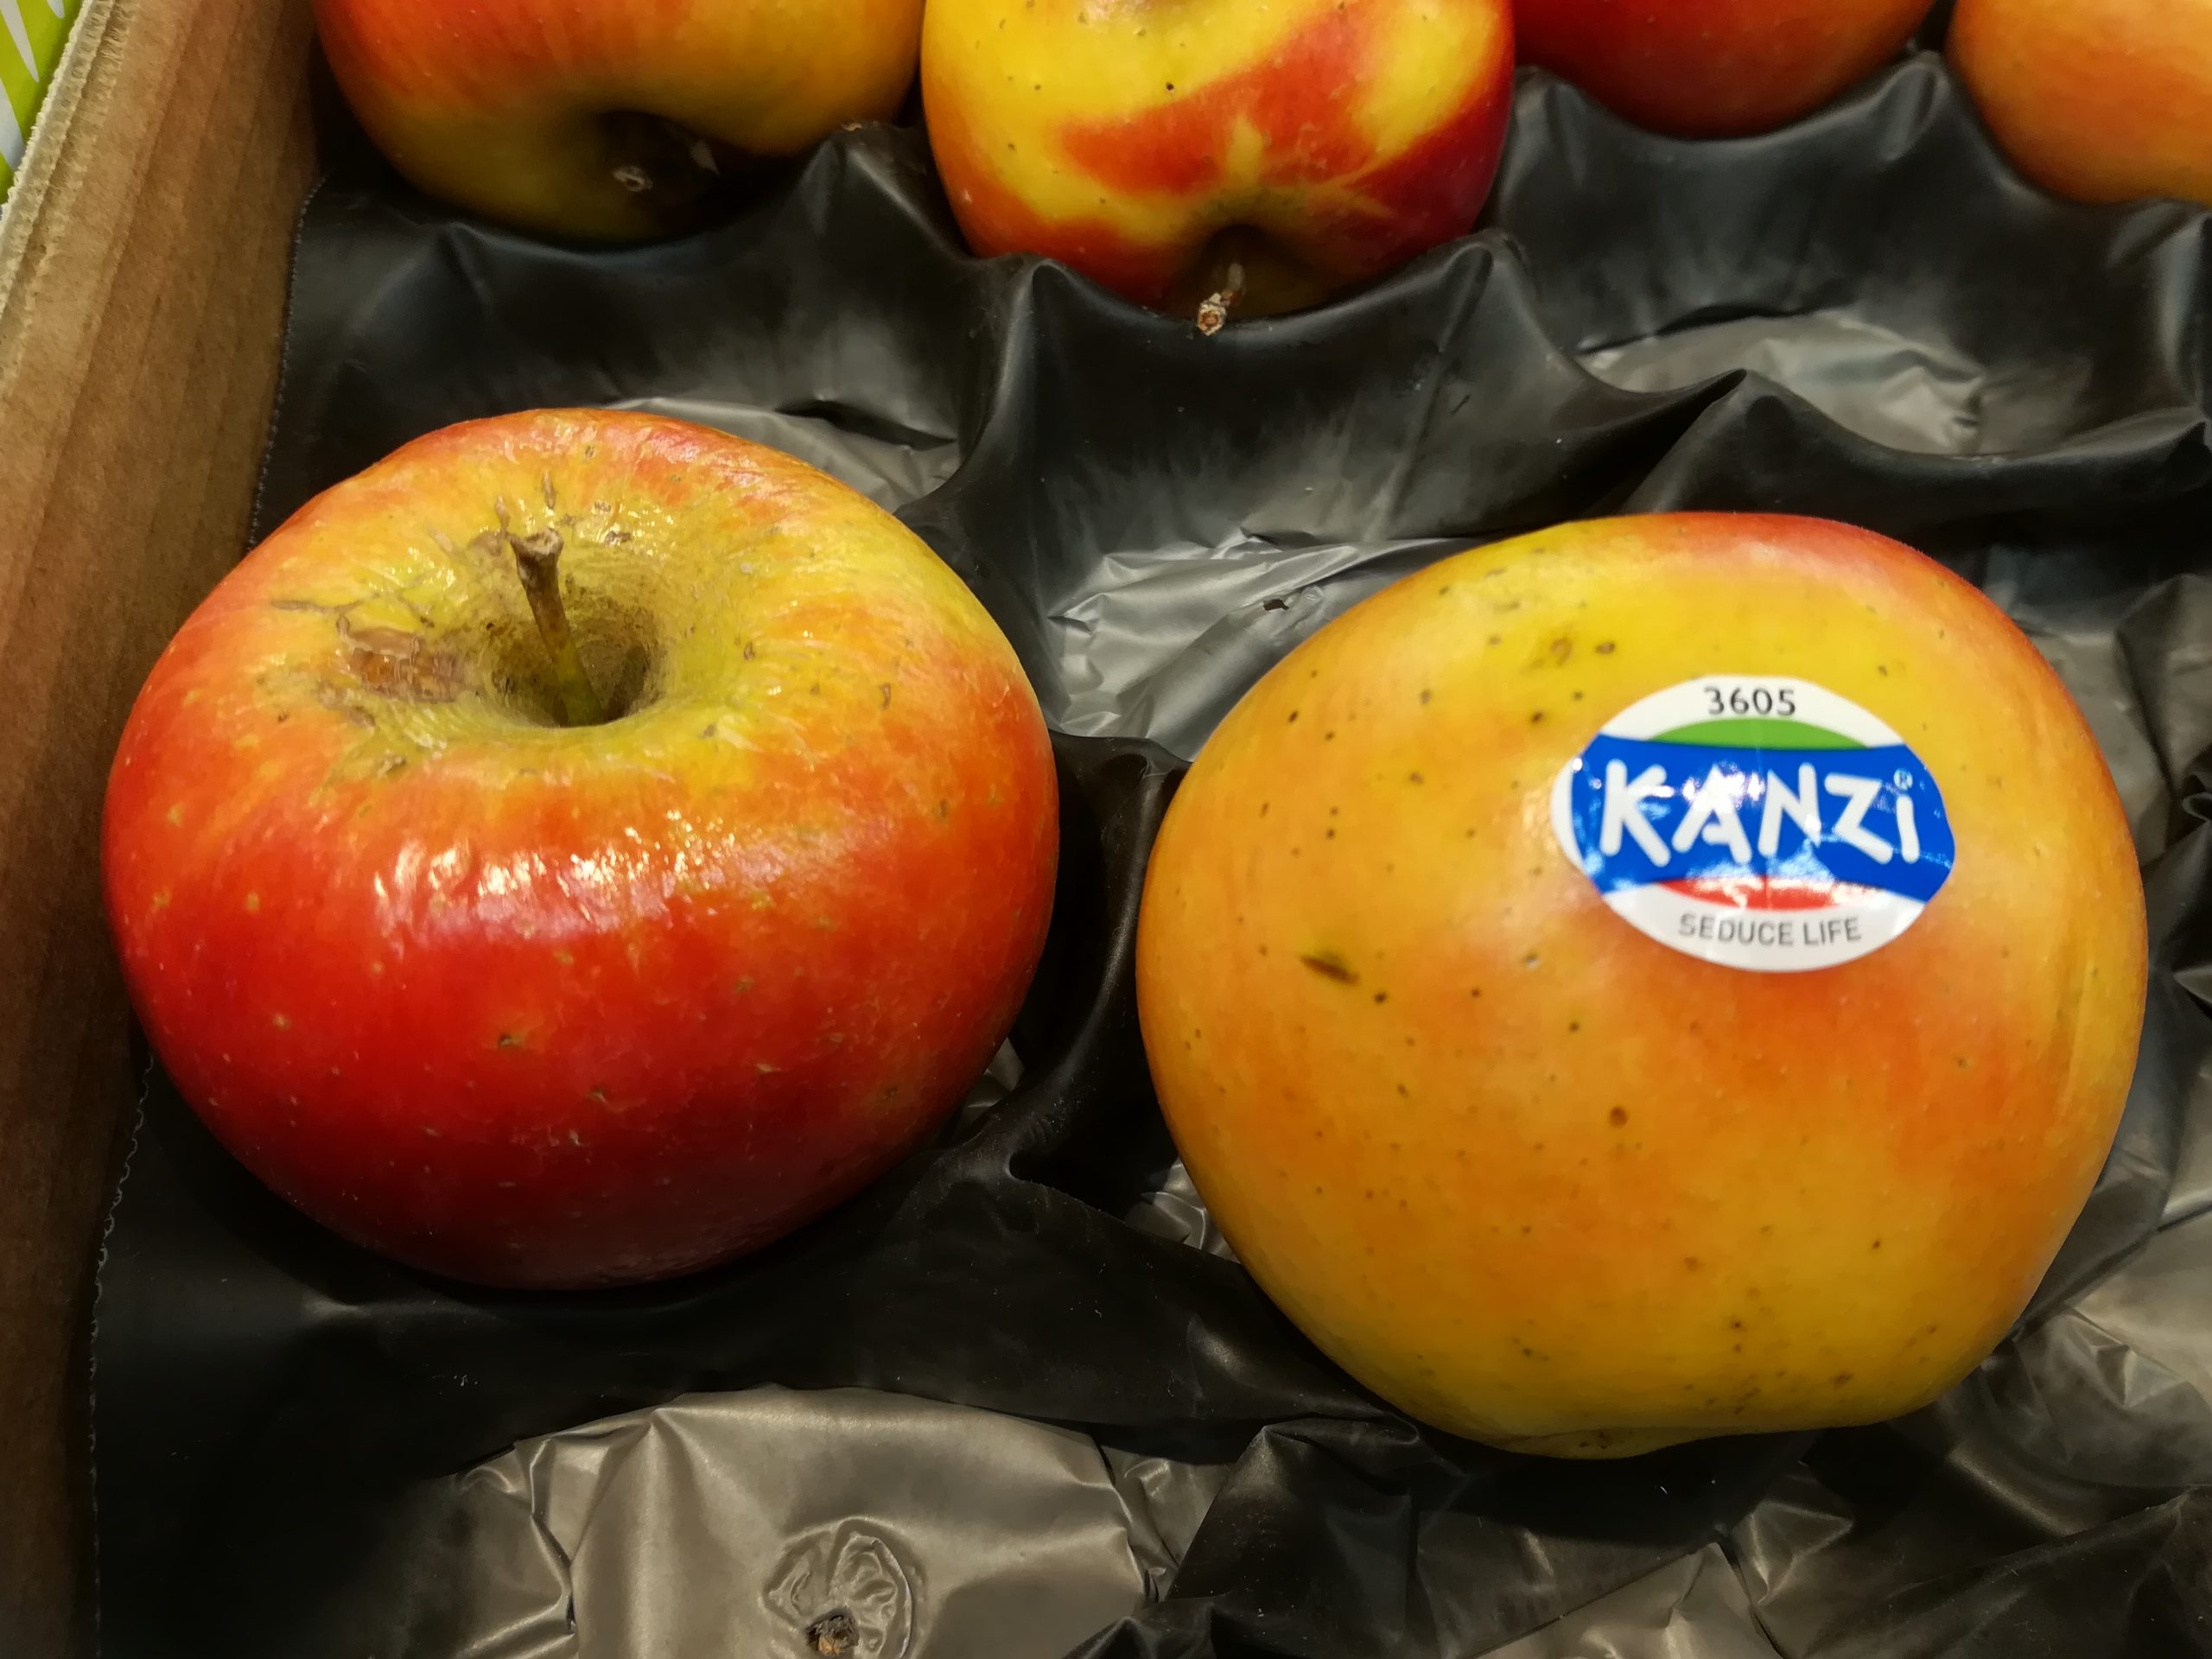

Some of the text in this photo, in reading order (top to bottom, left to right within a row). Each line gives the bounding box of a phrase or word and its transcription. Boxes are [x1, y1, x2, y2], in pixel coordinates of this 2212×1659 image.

[1704, 686, 1796, 716] 3605
[1678, 912, 1861, 945] SEDUCE LIFE
